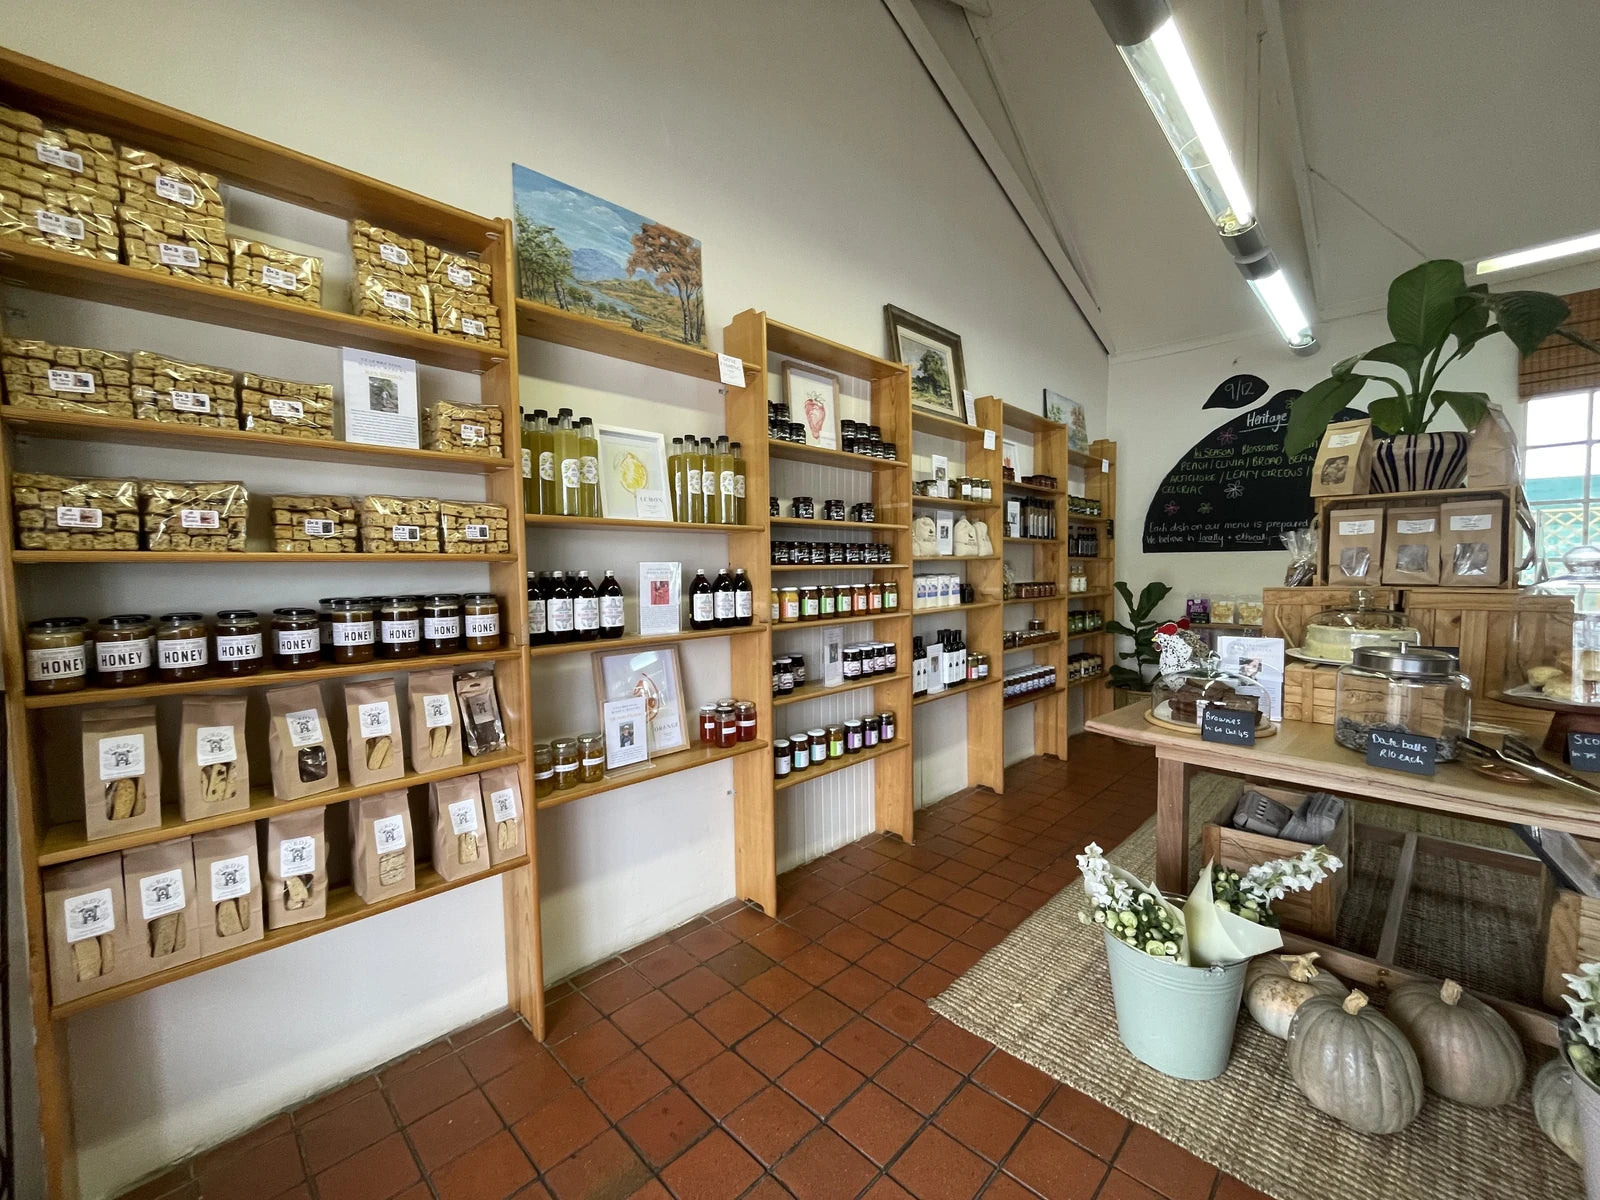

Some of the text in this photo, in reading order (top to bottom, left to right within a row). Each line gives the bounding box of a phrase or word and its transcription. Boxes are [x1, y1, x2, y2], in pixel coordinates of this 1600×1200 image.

[1224, 379, 1255, 401] 9/12
[1247, 411, 1287, 432] Heritage
[1204, 447, 1235, 457] SEASON
[1224, 522, 1250, 530] menu
[1265, 519, 1309, 533] prepared
[1199, 532, 1224, 547] locally
[389, 629, 416, 639] HONEY
[472, 623, 497, 633] HONEY
[344, 630, 372, 642] HONEY
[222, 644, 257, 657] HONEY
[281, 639, 313, 650] HONEY
[101, 651, 144, 667] HONEY
[164, 649, 203, 664] HONEY
[1205, 711, 1241, 725] Brownies
[1372, 733, 1428, 753] Date balls
[1380, 749, 1424, 765] R10 each
